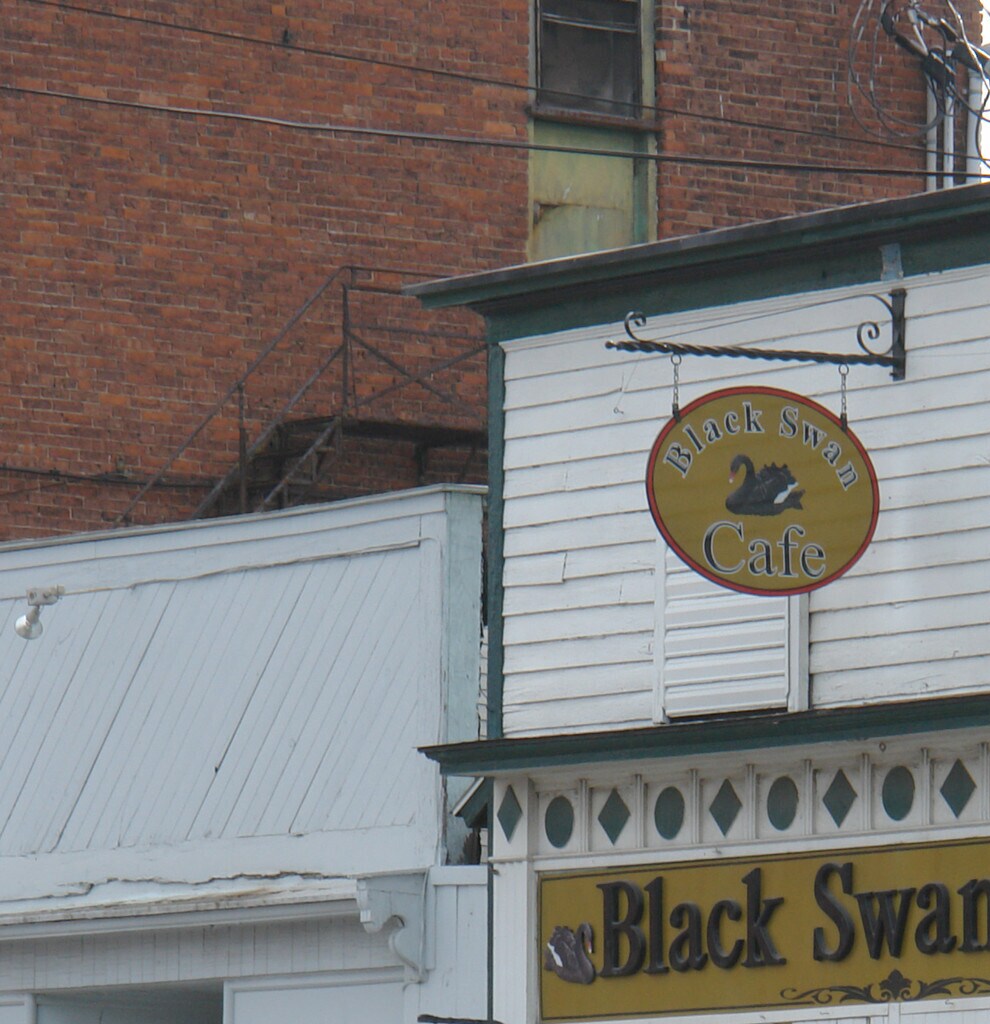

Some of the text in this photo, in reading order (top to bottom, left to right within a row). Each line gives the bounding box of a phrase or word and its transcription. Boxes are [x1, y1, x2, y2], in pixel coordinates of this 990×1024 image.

[664, 402, 859, 490] Black Swan
[703, 520, 826, 578] Cafe
[595, 868, 786, 978] Black
